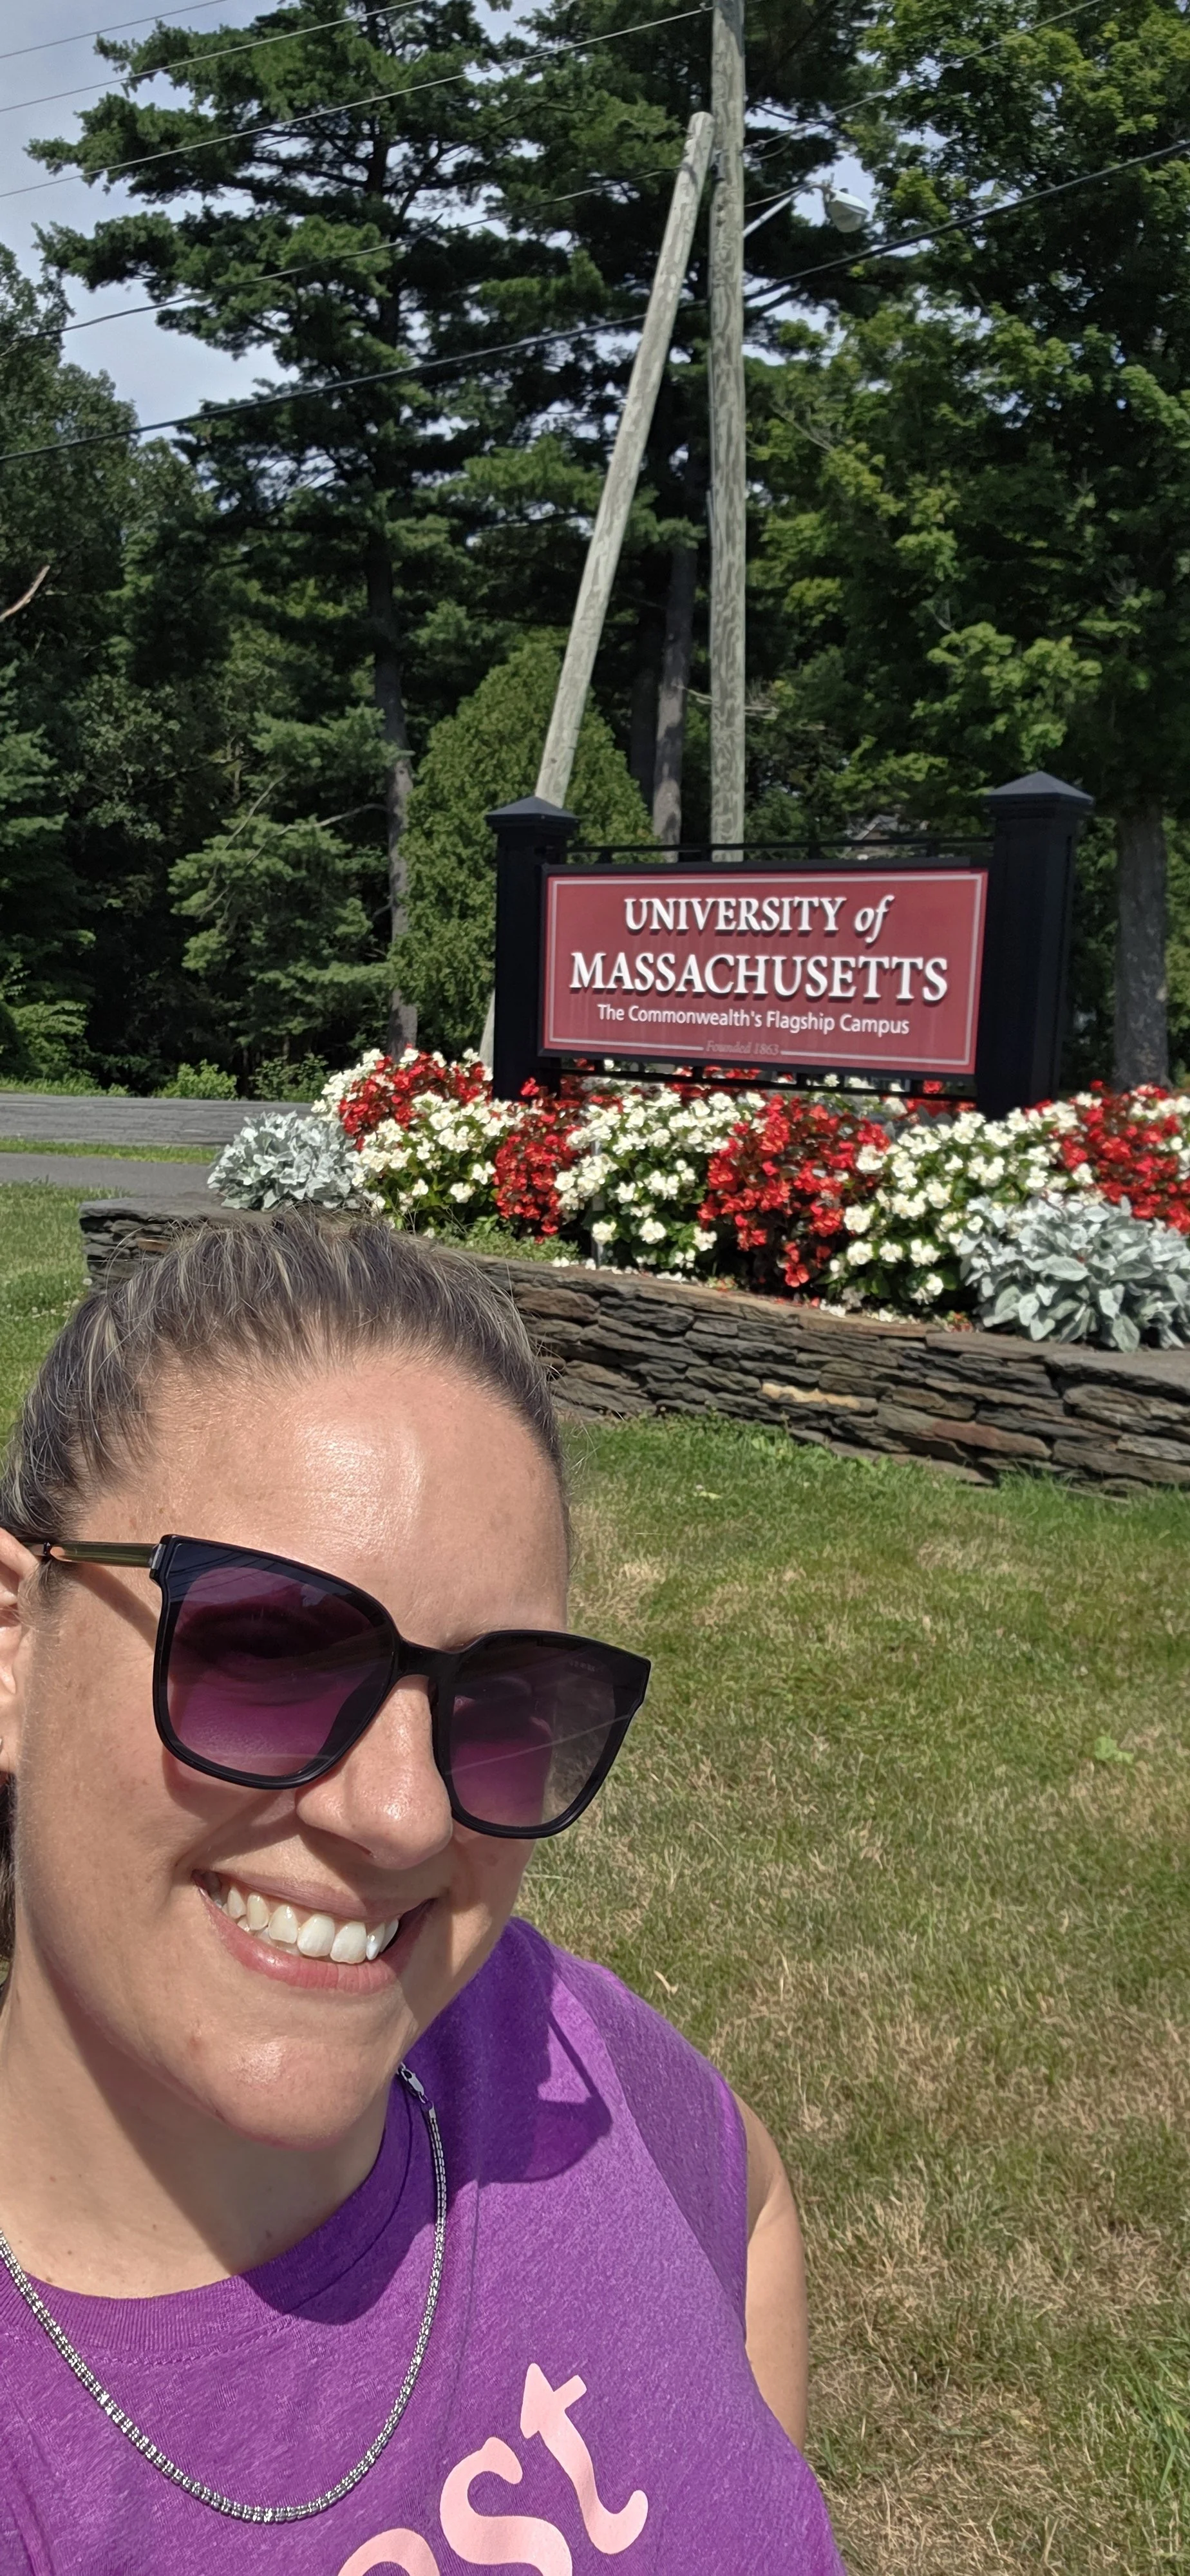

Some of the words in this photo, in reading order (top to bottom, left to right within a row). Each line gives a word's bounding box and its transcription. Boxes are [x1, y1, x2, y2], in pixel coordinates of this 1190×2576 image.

[624, 897, 846, 932] UNIVERSITY
[854, 894, 895, 943] of
[569, 951, 949, 1003] MASSACHUSETTS
[597, 1003, 625, 1021] The
[628, 1005, 763, 1028] Commonwealth's
[766, 1010, 836, 1035] Flagship
[840, 1013, 910, 1038] Campus
[706, 1040, 752, 1054] Founded
[753, 1042, 779, 1056] 1863
